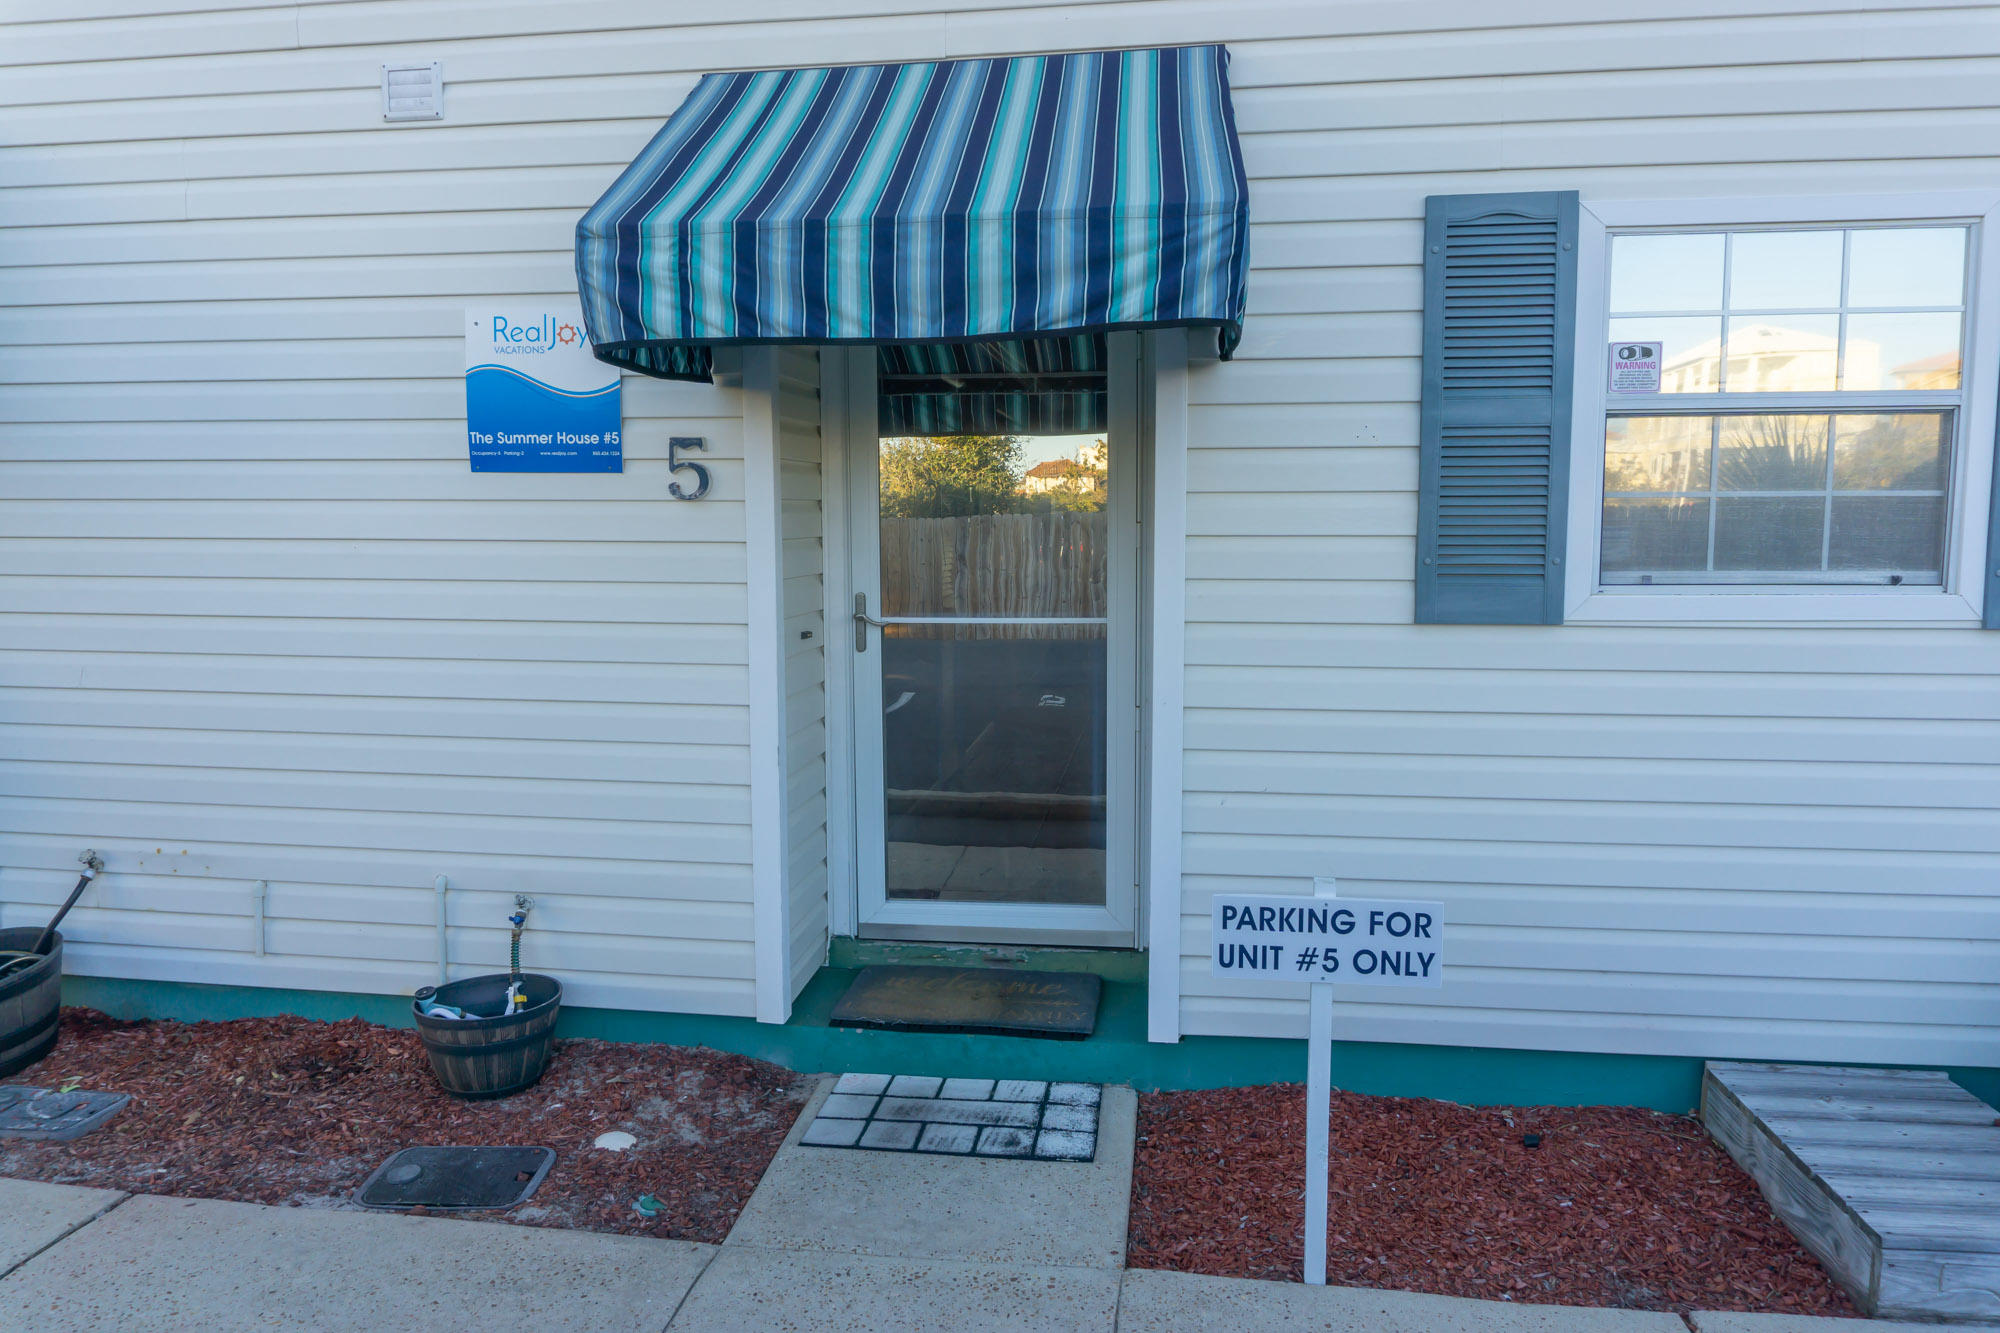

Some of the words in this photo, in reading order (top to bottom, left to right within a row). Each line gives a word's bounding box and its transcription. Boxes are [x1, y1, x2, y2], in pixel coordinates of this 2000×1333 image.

[494, 345, 545, 354] VACATIONS
[1615, 361, 1656, 370] WARNING
[469, 431, 493, 444] The
[497, 431, 553, 444] Summer
[557, 431, 599, 444] House
[604, 431, 620, 444] #5
[668, 436, 713, 501] 5
[1221, 905, 1356, 935] PARKING
[1369, 911, 1432, 938] FOR
[1219, 943, 1284, 970] UNIT
[1296, 947, 1339, 973] #5
[1353, 949, 1436, 977] ONLY
